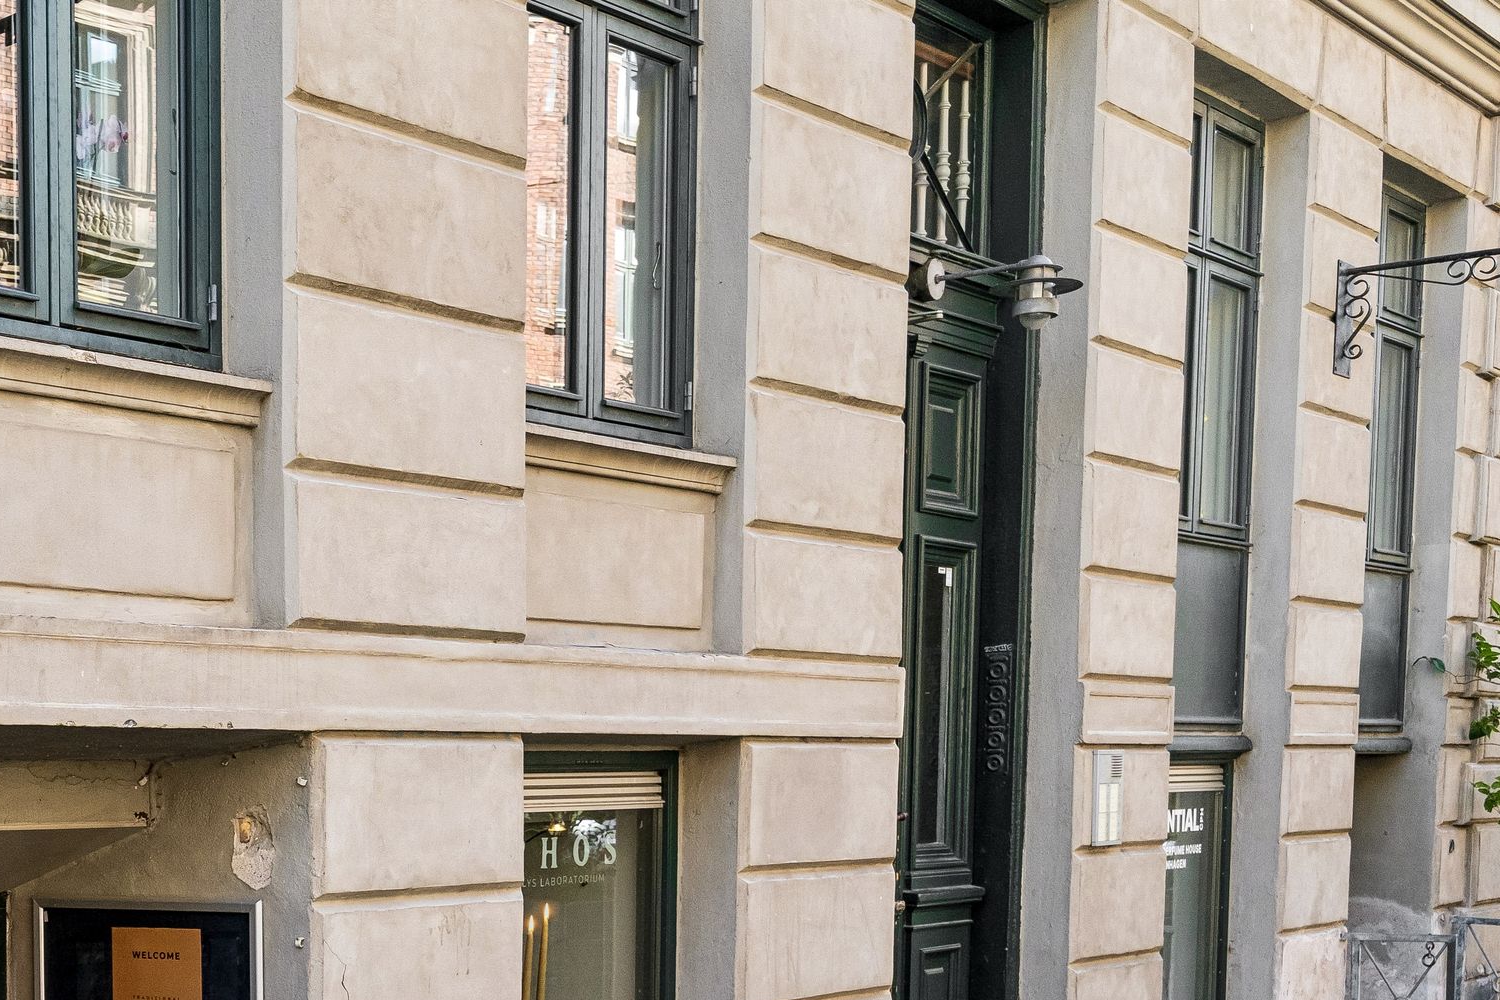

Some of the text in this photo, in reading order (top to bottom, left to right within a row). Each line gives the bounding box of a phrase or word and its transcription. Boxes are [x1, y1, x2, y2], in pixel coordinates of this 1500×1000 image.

[1167, 808, 1199, 832] NTIAL
[1186, 844, 1202, 854] HOUSE
[540, 874, 605, 887] LABORATORIUM
[132, 951, 180, 960] WELCOME
